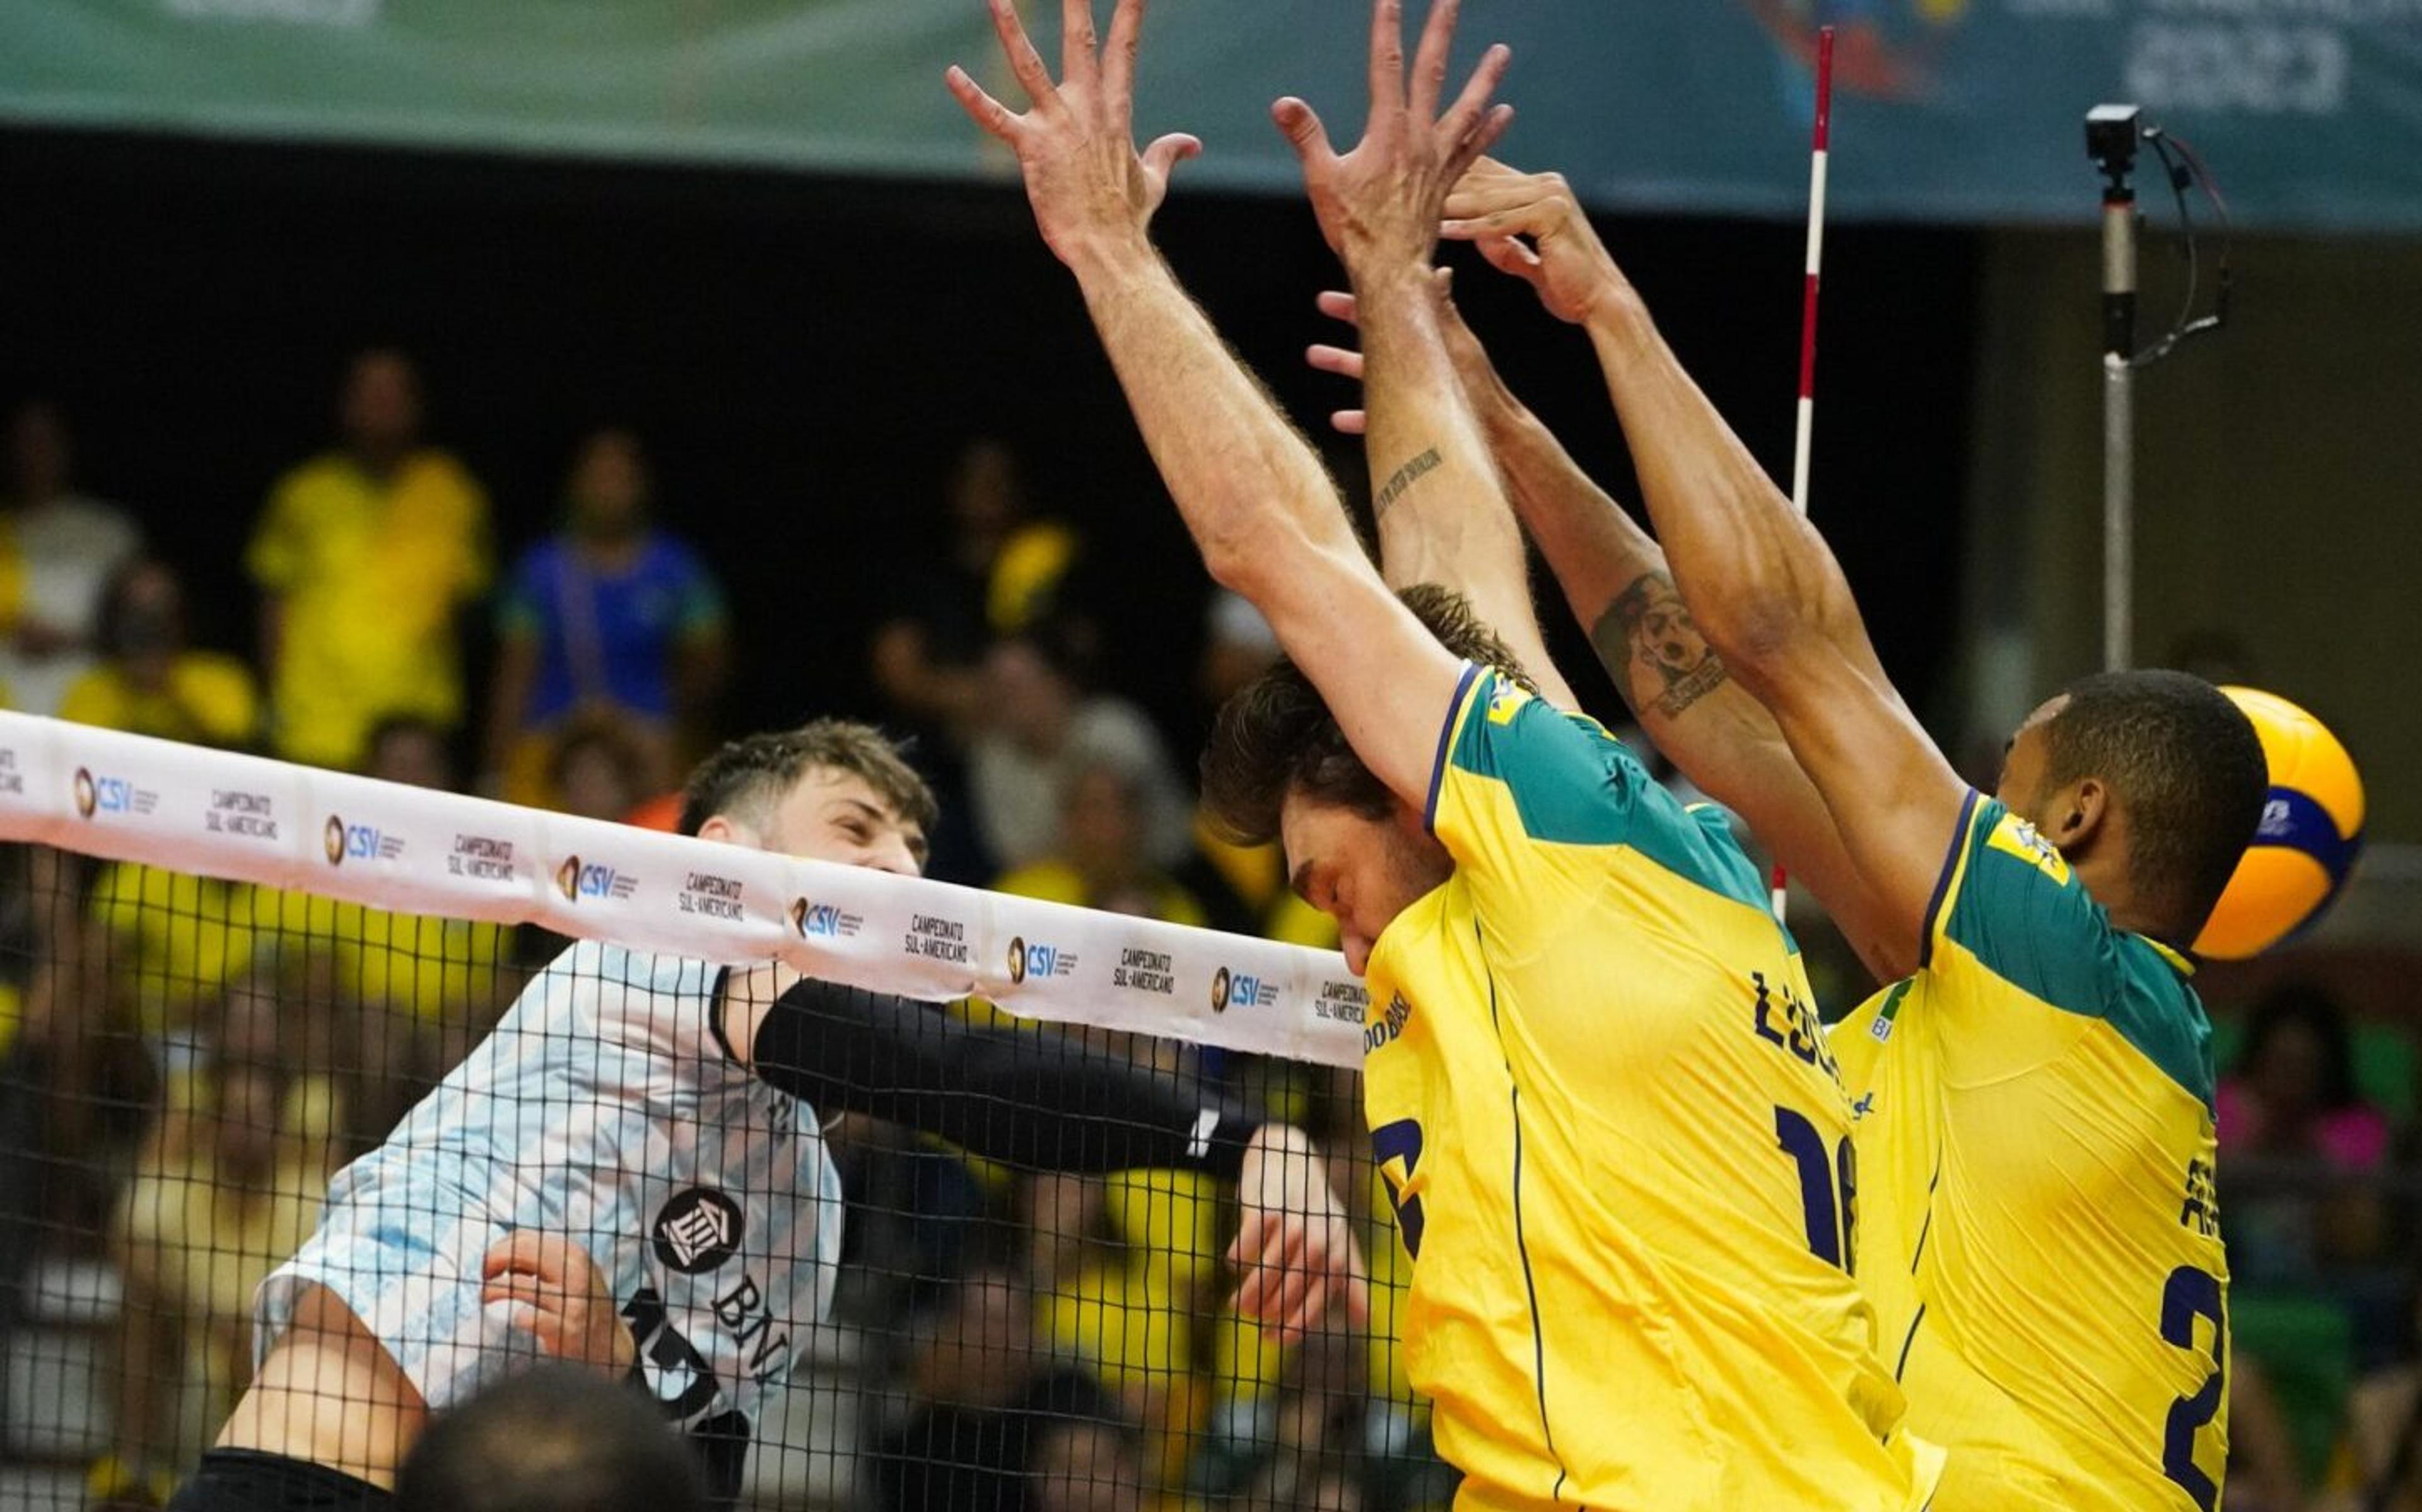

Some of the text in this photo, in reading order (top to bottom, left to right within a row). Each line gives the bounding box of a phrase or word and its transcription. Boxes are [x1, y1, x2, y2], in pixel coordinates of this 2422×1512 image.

[97, 776, 132, 812] CSV
[347, 825, 380, 859] CSV
[579, 864, 615, 897] CSV
[686, 872, 742, 900] CAMPEONATO
[805, 904, 840, 936] CSV
[911, 914, 964, 941] CAMPEONATO
[1027, 945, 1056, 977] CSV
[1121, 948, 1173, 974] CAMPEONATO
[1231, 974, 1260, 1006] CSV
